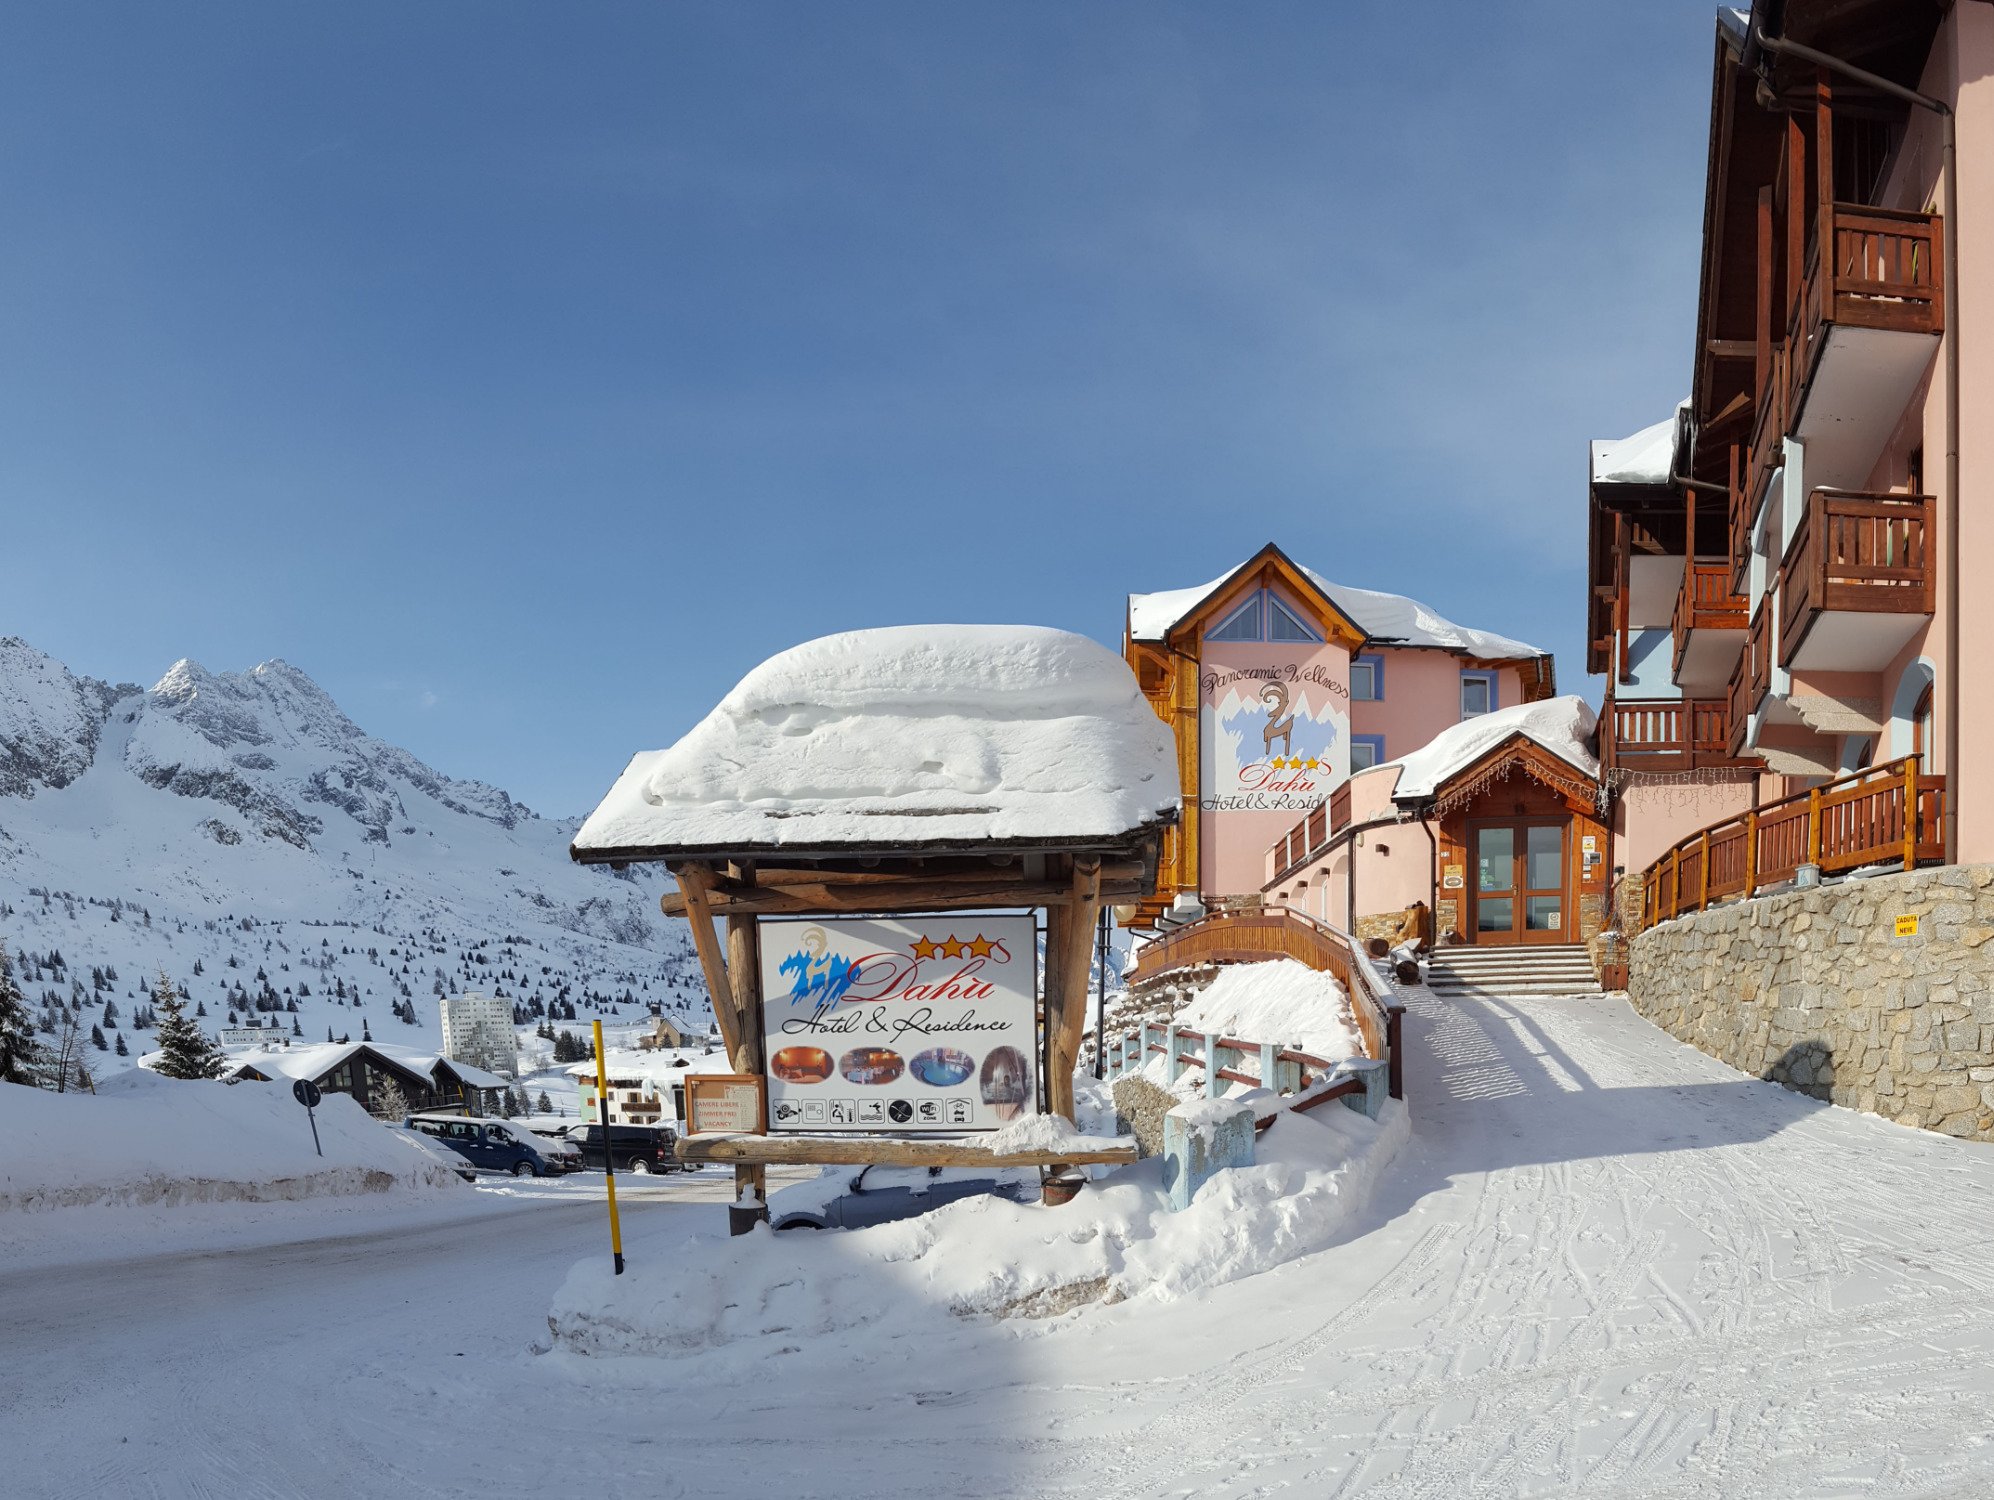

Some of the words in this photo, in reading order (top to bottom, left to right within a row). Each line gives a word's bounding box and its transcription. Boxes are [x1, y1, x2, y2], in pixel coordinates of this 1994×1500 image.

[1202, 665, 1282, 695] Panoramic
[1285, 663, 1349, 699] Wellness
[1202, 793, 1254, 811] Hotel
[1255, 793, 1270, 810] &
[1271, 793, 1323, 810] Resid
[1896, 916, 1917, 924] CADUTA
[841, 952, 996, 1002] Dahù
[781, 1003, 863, 1035] Hotel
[865, 1005, 889, 1033] &
[889, 1007, 1013, 1044] Residence
